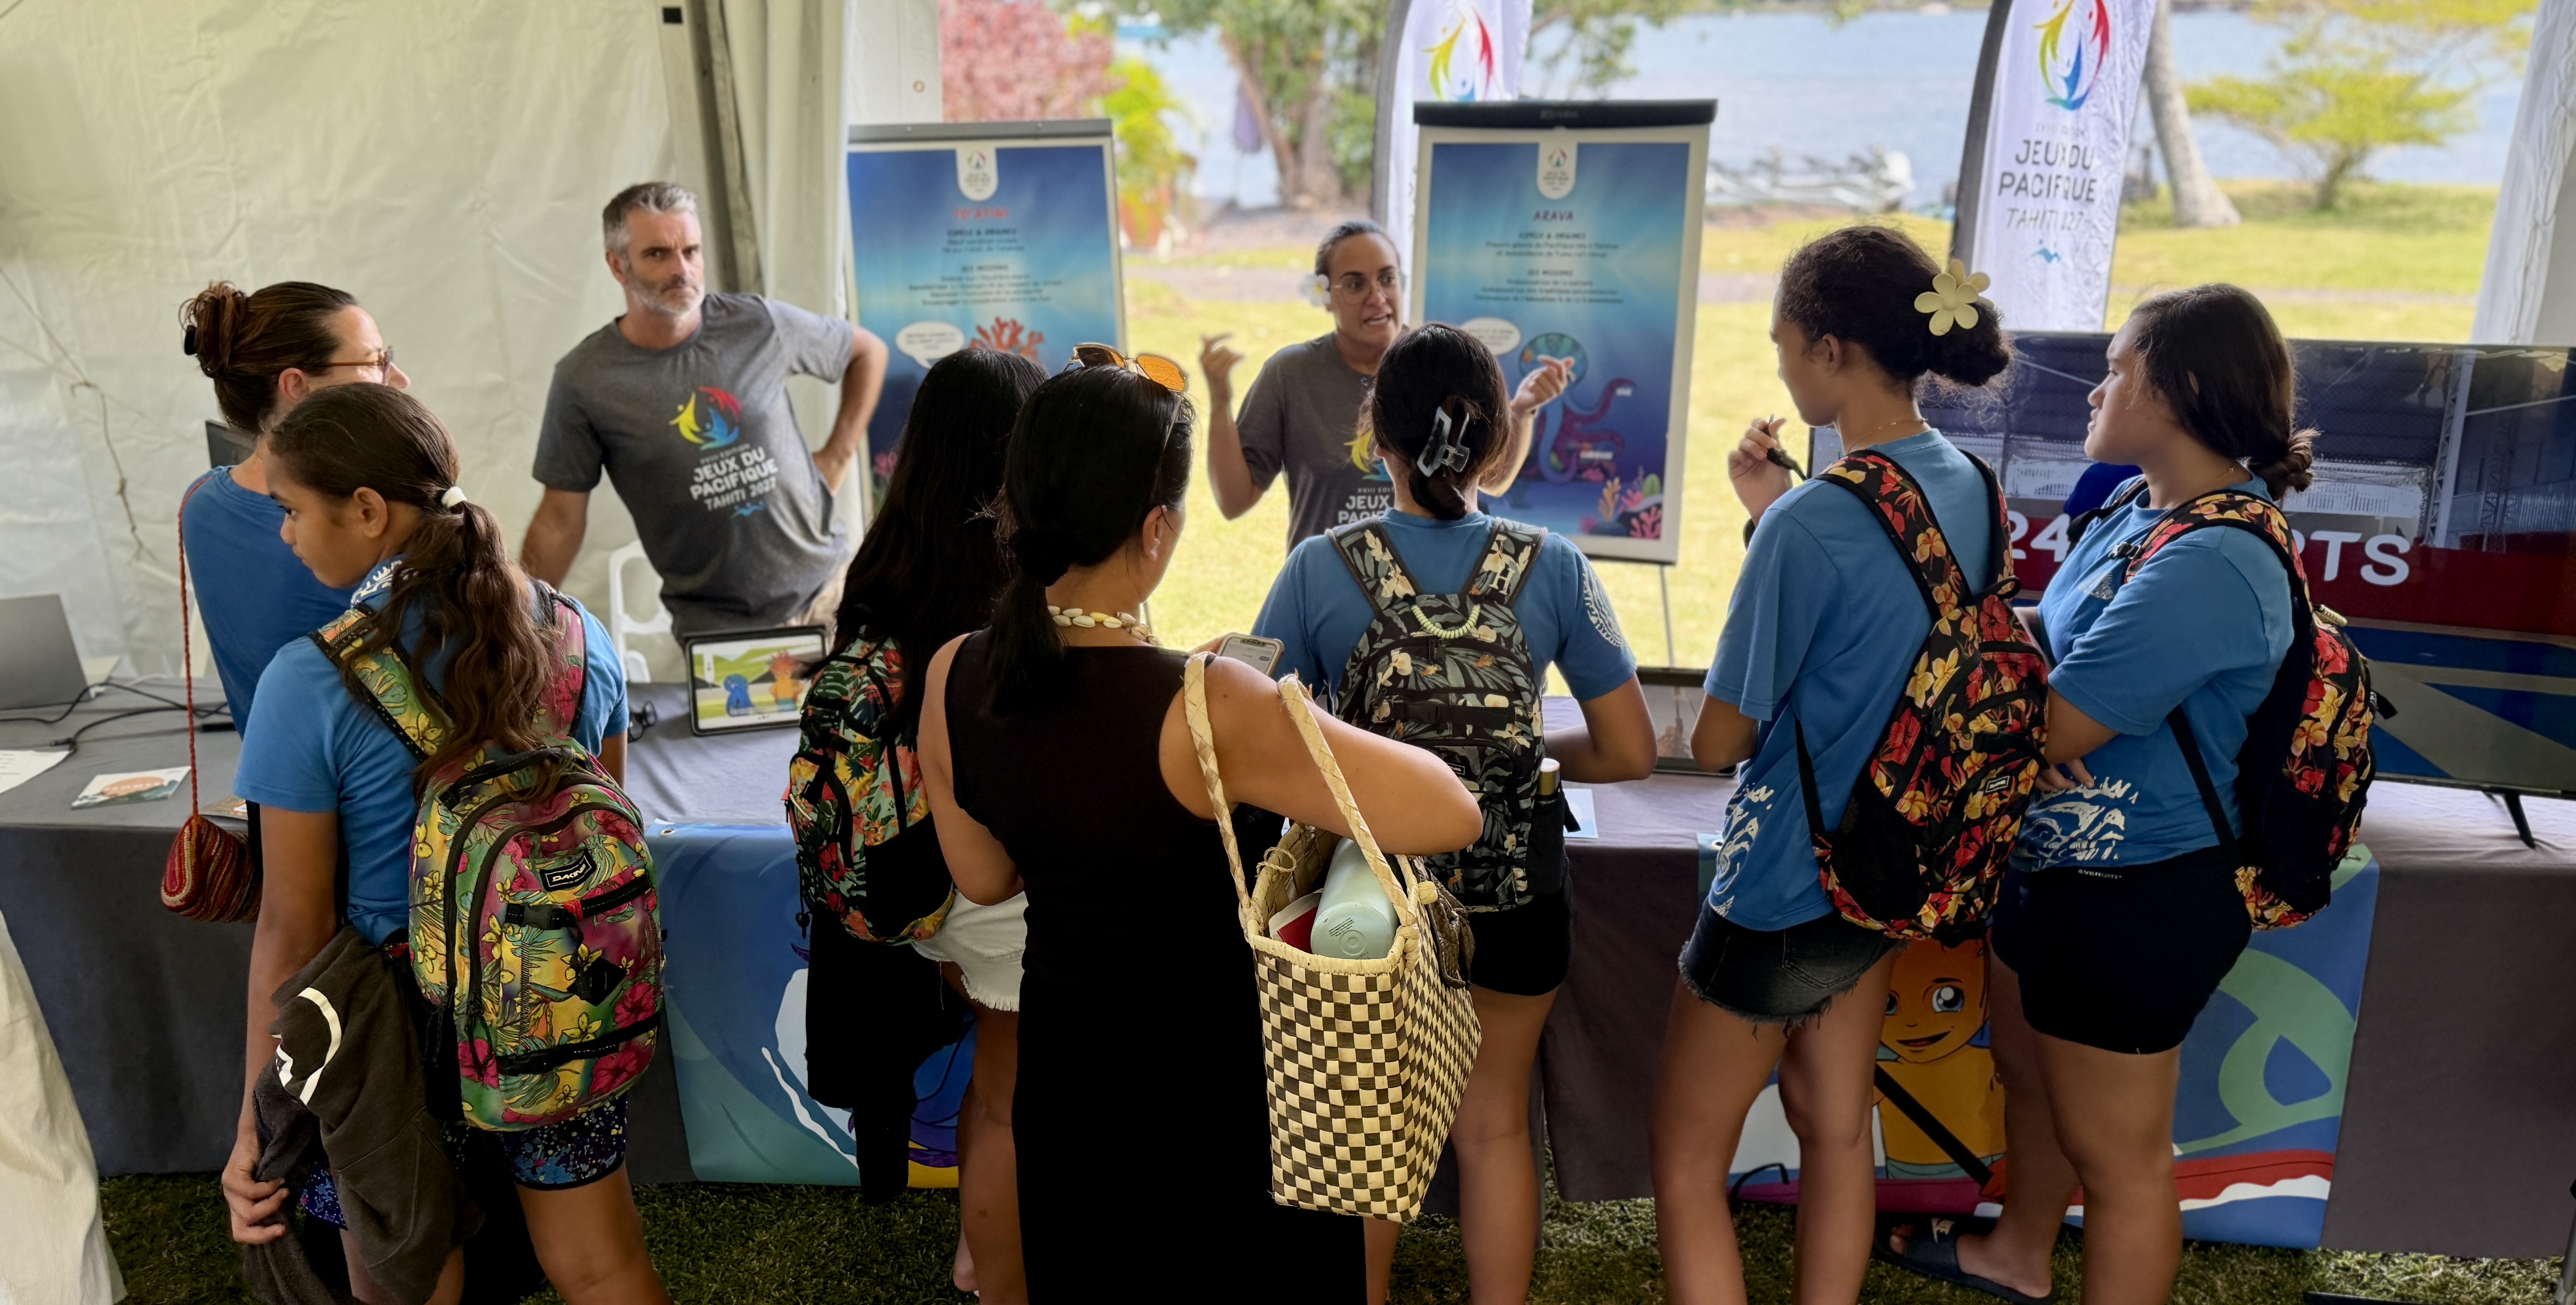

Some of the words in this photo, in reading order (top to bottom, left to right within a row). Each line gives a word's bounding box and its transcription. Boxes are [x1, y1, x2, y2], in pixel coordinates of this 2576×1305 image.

[2069, 145, 2095, 170] DU
[1998, 171, 2098, 203] PACIFQUE
[1533, 210, 1574, 222] ARAVA
[690, 458, 779, 500] PACIFIQUE
[693, 456, 740, 483] JEUX
[740, 446, 766, 467] DU
[704, 488, 746, 510] TAHITI
[750, 477, 776, 497] 2027
[1346, 495, 1390, 510] JEUX
[2007, 510, 2071, 562] 24
